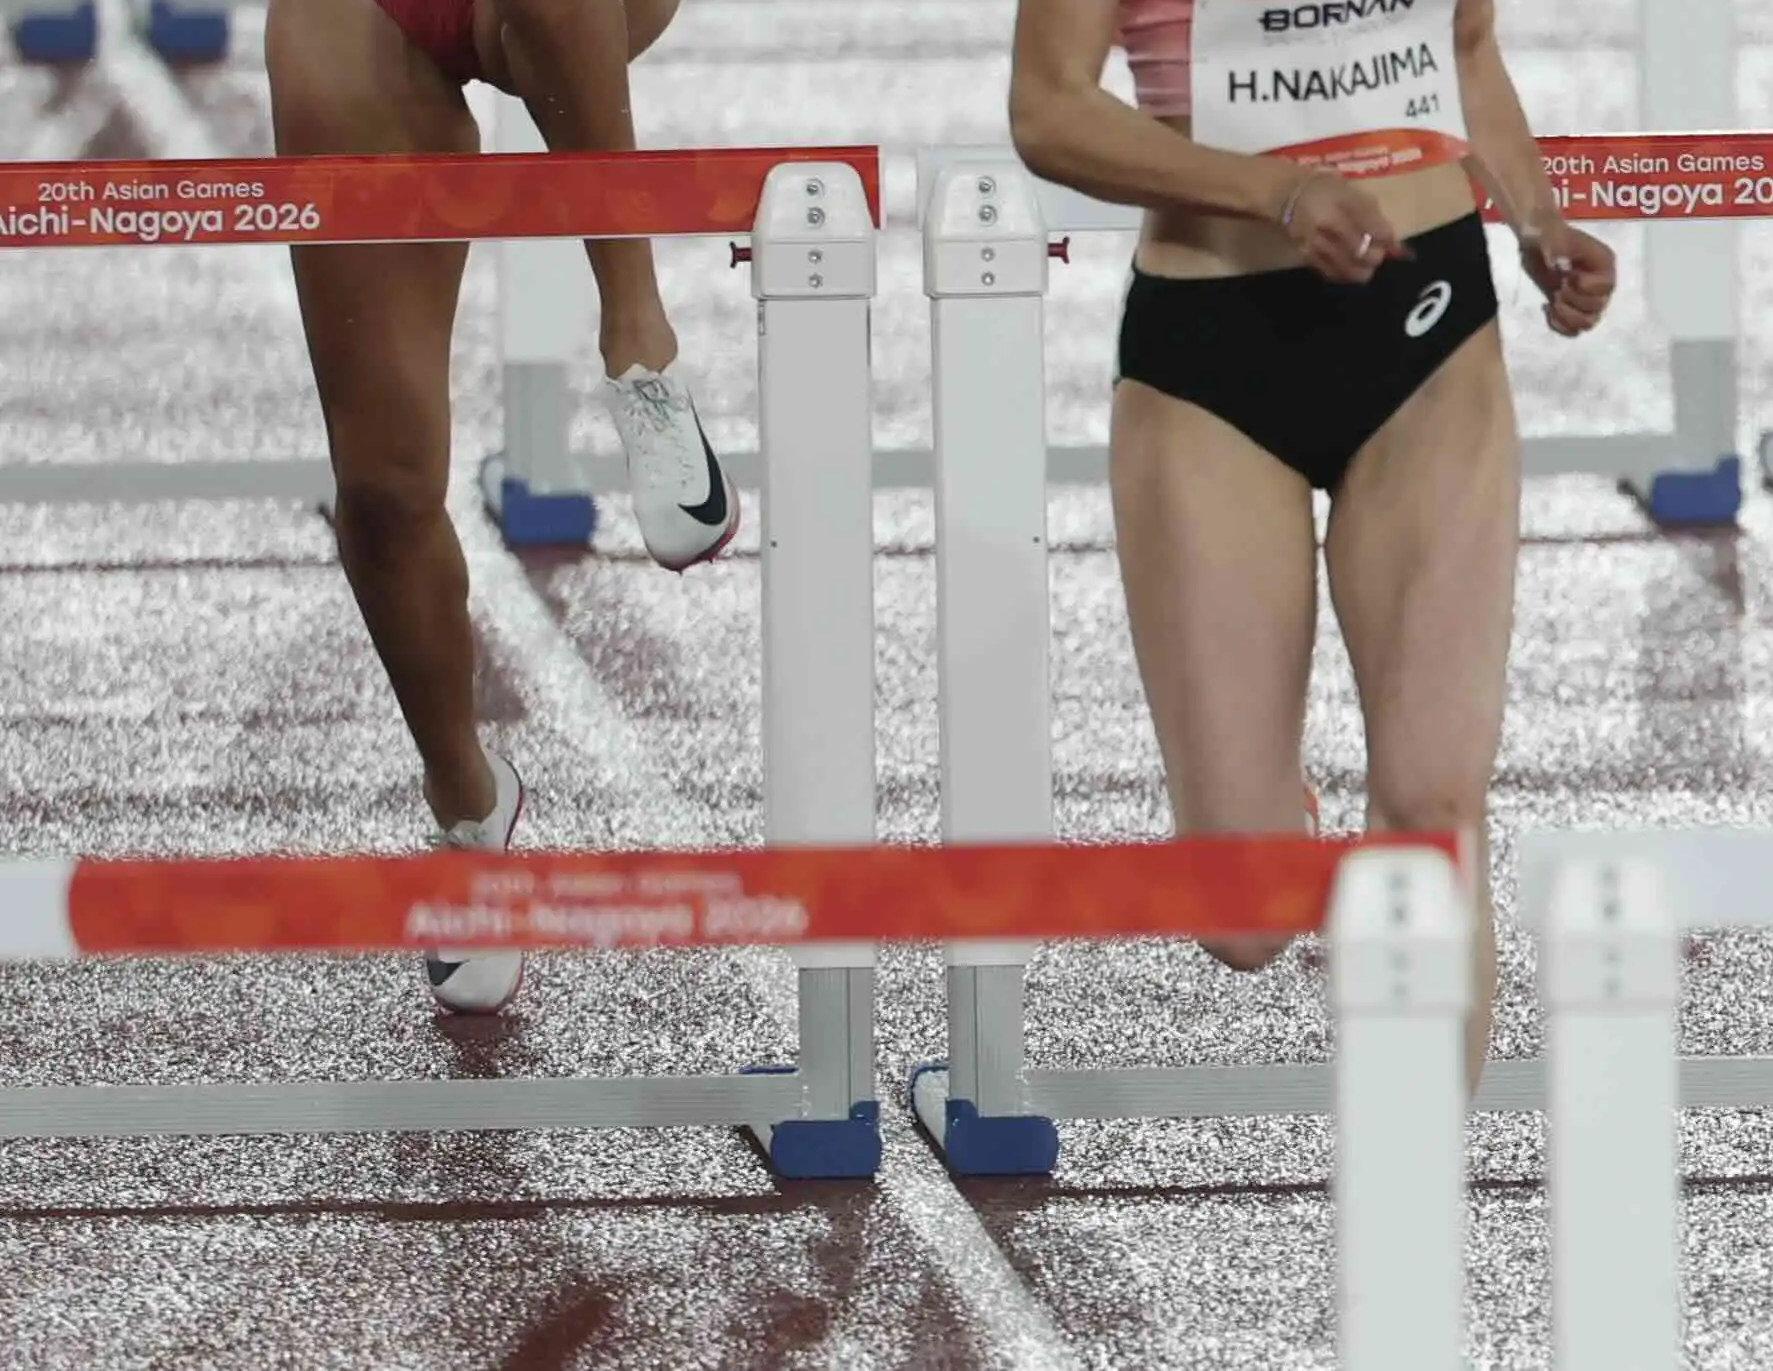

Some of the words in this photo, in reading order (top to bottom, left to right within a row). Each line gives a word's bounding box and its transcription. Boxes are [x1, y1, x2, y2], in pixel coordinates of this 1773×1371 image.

[1229, 42, 1440, 103] H.NAKAJIMA
[1405, 93, 1441, 118] 441
[1542, 155, 1595, 176] 20th
[1601, 153, 1669, 174] Asian
[1677, 153, 1765, 172] Games
[38, 182, 95, 202] 20th
[102, 180, 169, 200] Asian
[177, 181, 265, 199] Games
[0, 206, 223, 241] ichi-Nagoya
[234, 203, 321, 231] 2026
